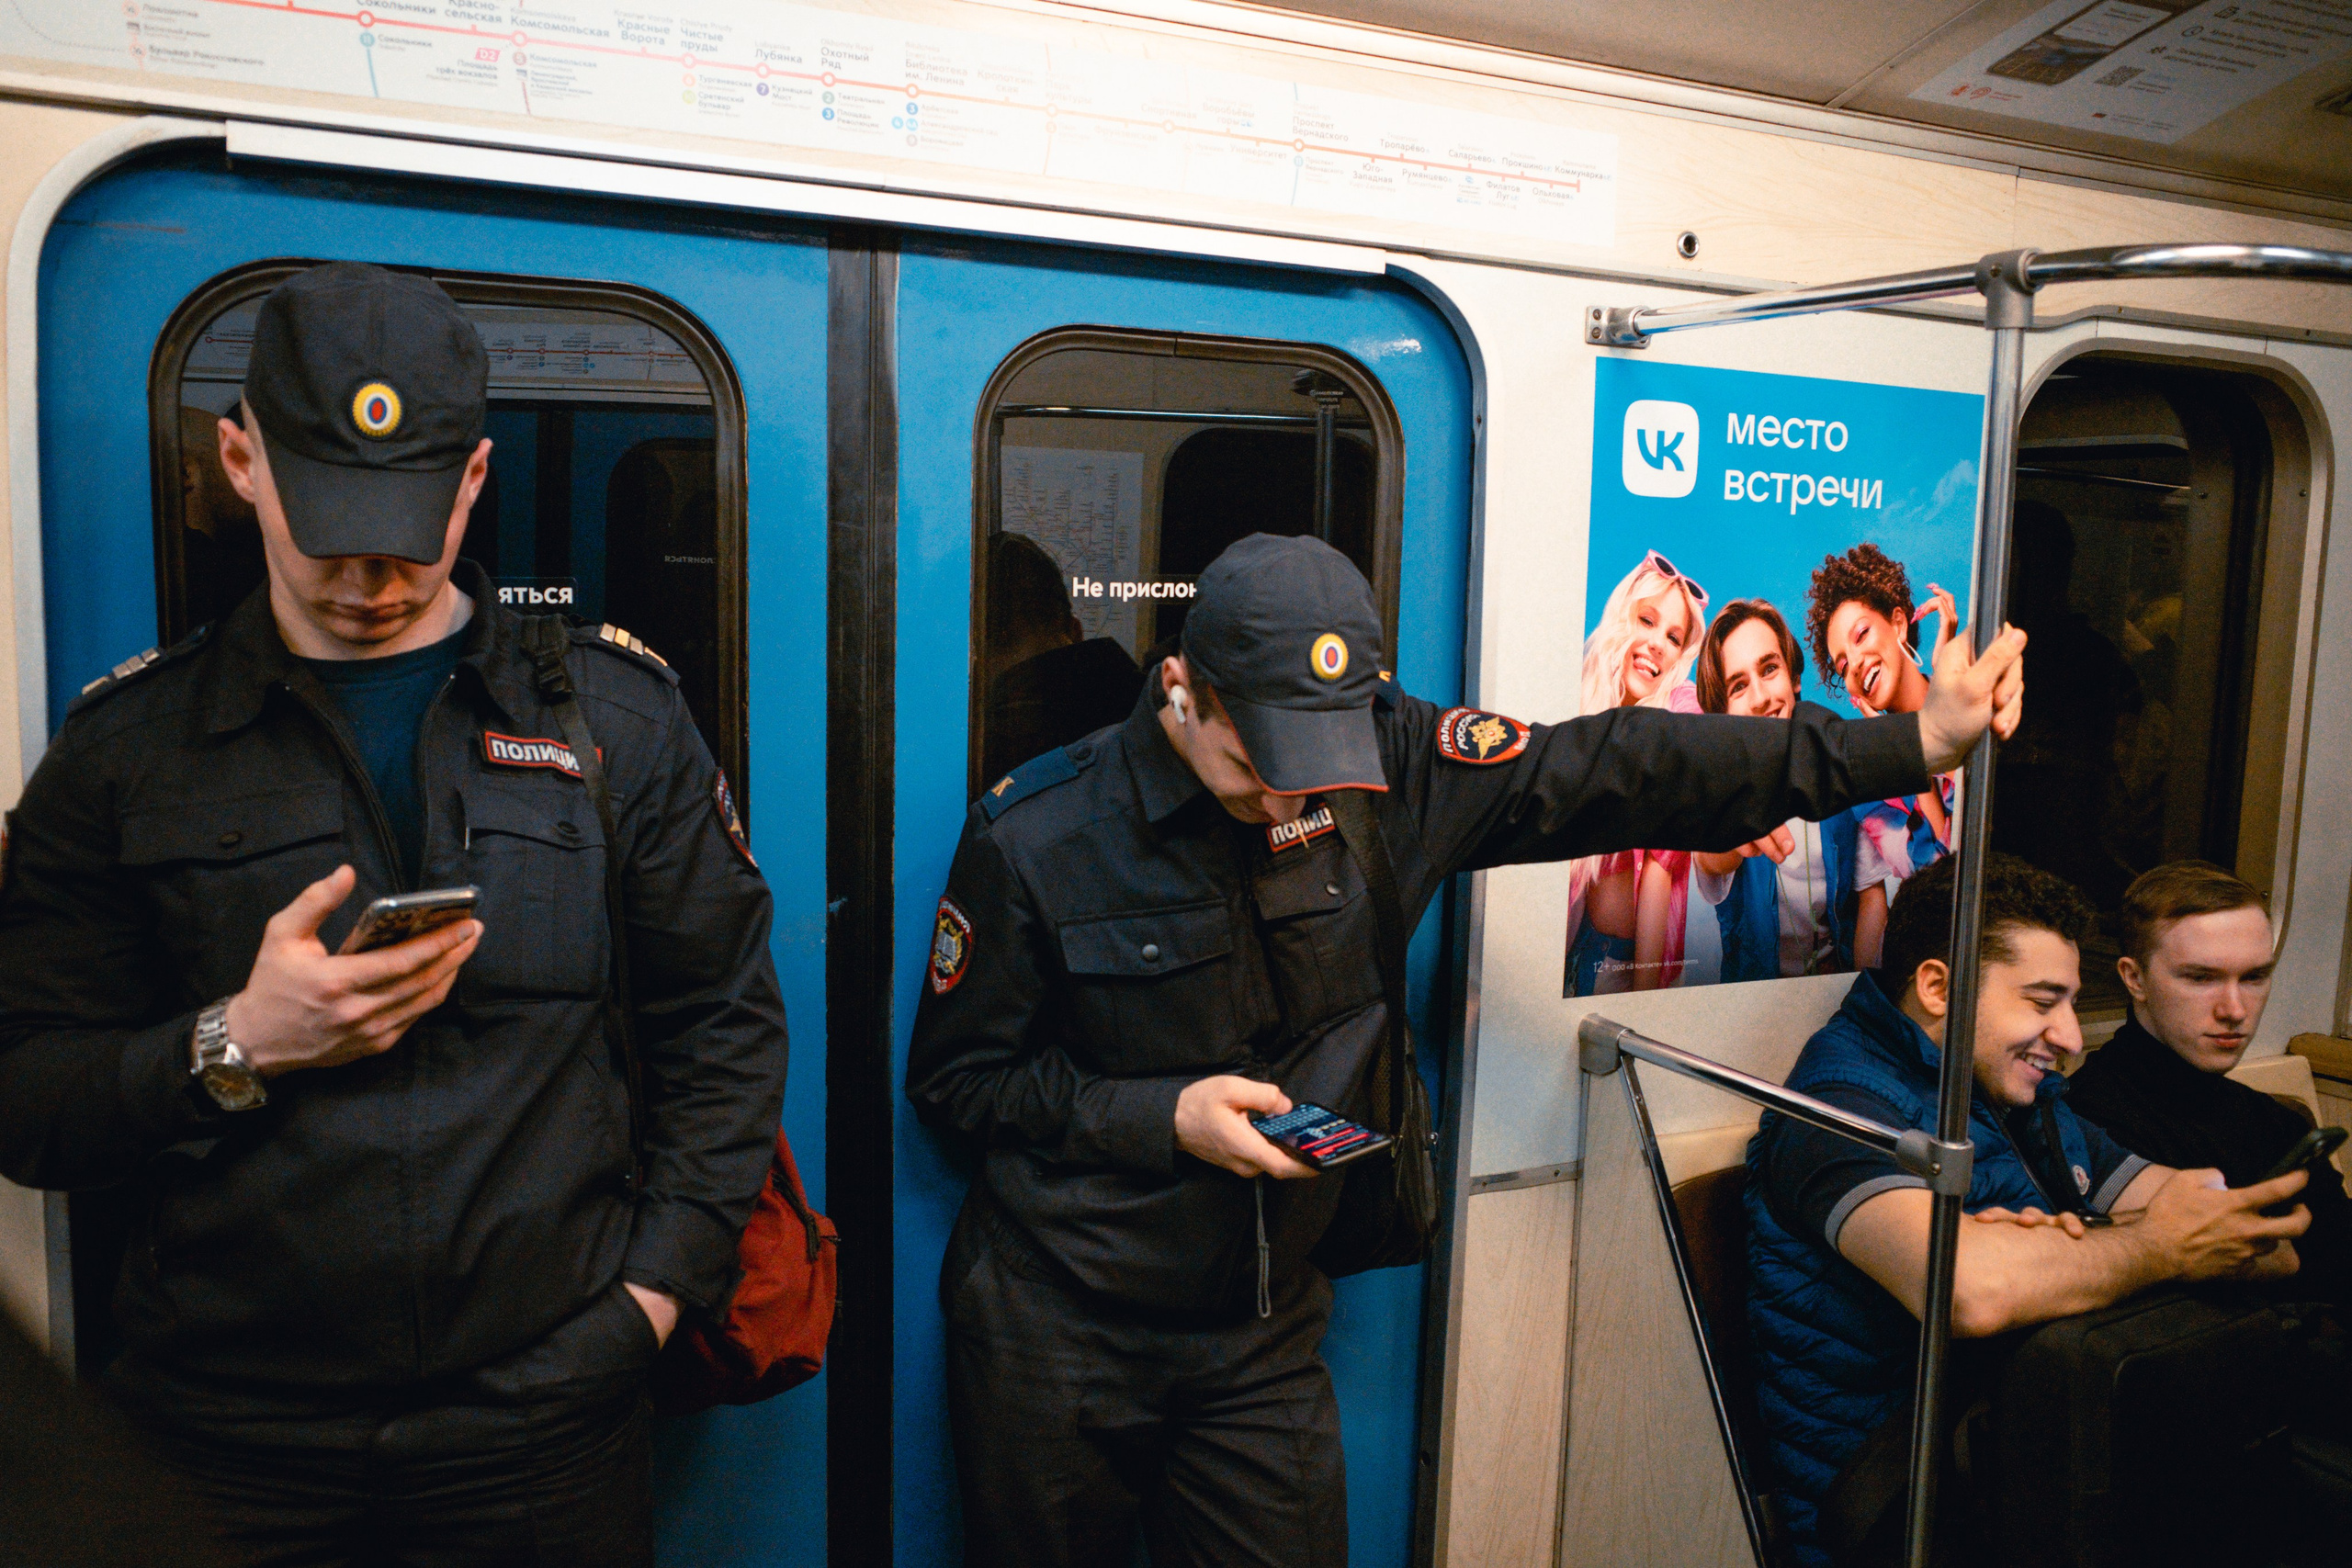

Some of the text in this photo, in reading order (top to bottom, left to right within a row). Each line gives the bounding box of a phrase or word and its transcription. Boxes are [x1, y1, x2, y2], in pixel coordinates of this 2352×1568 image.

[356, 0, 437, 15] Сокольники
[448, 0, 500, 11] Красно-
[444, 7, 502, 22] сельская
[511, 16, 610, 37] Комсомольская
[616, 17, 671, 35] Красные
[378, 34, 432, 48] Сокольники
[621, 29, 665, 46] Ворота
[680, 26, 724, 42] Чистые
[680, 40, 718, 52] пруды
[529, 53, 597, 68] Комсомольская
[755, 49, 803, 64] Лубянка
[820, 46, 869, 62] Охотный
[821, 58, 842, 70] Ряд
[905, 58, 968, 76] Библиотека
[698, 74, 752, 87] Тургеневская
[905, 72, 965, 86] им. Ленина
[977, 70, 1036, 85] Кропоткин-
[1046, 79, 1071, 90] Парк
[772, 85, 813, 95] Кузнецкий
[995, 84, 1019, 94] ская
[698, 92, 744, 103] Сретенский
[772, 93, 792, 101] Мост
[838, 93, 886, 105] Театральная
[1046, 92, 1092, 105] культуры
[837, 108, 872, 119] Площадь
[921, 104, 959, 114] Арбатская
[1140, 103, 1197, 119] Спортивная
[1202, 102, 1255, 118] Воробьёвы
[837, 118, 879, 129] Революции
[1216, 116, 1240, 126] горы
[1292, 116, 1335, 130] Проспект
[1094, 125, 1158, 141] Фрунзенская
[1292, 126, 1349, 142] Вернадского
[921, 136, 965, 146] Боровицкая
[1379, 138, 1425, 153] Тропарёво
[1229, 143, 1287, 159] Университет
[1448, 149, 1492, 163] Саларьево
[1305, 156, 1334, 165] Проспект
[1501, 157, 1544, 171] Прокшино
[1305, 164, 1344, 175] Вернадского
[1362, 163, 1384, 173] Юго-
[1555, 165, 1604, 180] Коммунарка
[1352, 170, 1393, 184] Западная
[1402, 168, 1448, 183] Румянцево
[1487, 180, 1521, 193] Филатов
[1532, 186, 1570, 199] Ольховая
[1496, 191, 1510, 201] Луг
[1726, 412, 1849, 452] место
[1724, 468, 1883, 515] встречи
[497, 587, 573, 604] яться
[1072, 576, 1198, 603] Не прислон
[491, 739, 582, 772] ПОЛИЦИ
[1271, 807, 1335, 845] ПОЛИЦ
[1593, 960, 1610, 973] 12+
